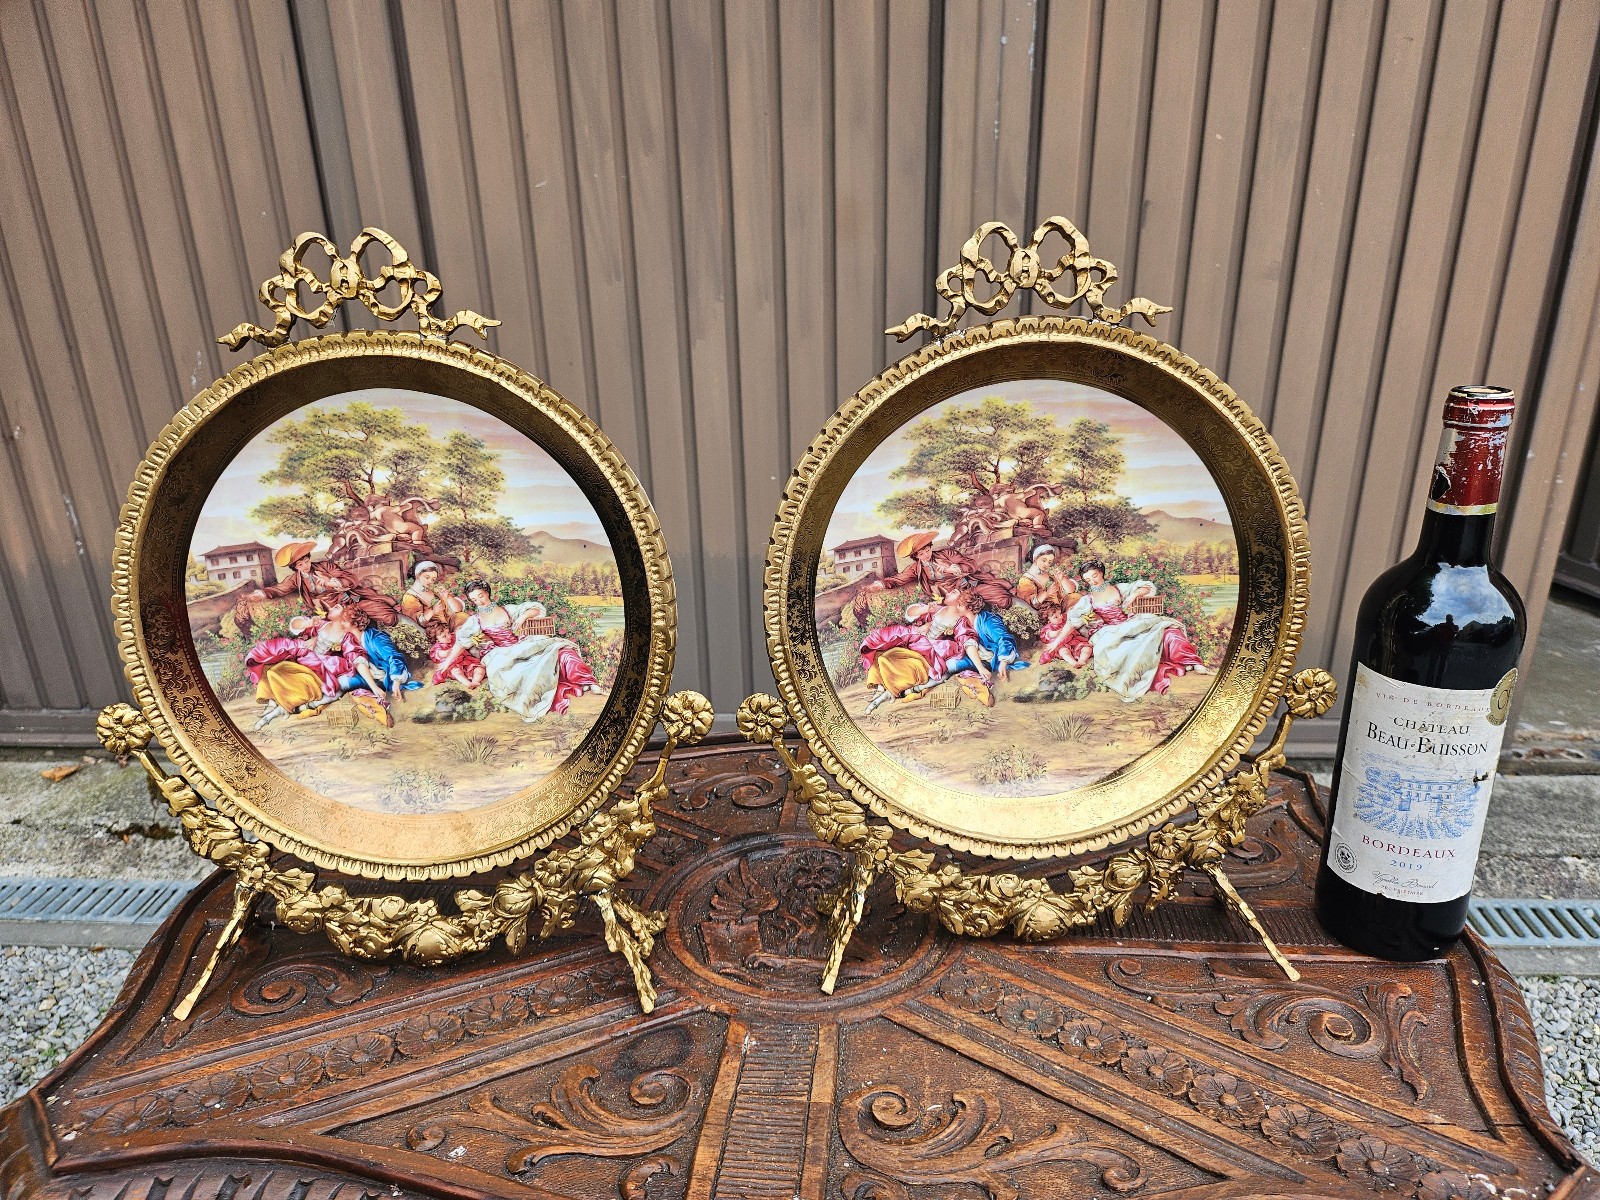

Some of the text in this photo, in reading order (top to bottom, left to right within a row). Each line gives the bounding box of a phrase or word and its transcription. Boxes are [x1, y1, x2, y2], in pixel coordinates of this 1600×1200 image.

[1403, 697, 1418, 705] DE
[1362, 835, 1456, 858] BORDEAUX
[1390, 860, 1423, 871] 2019
